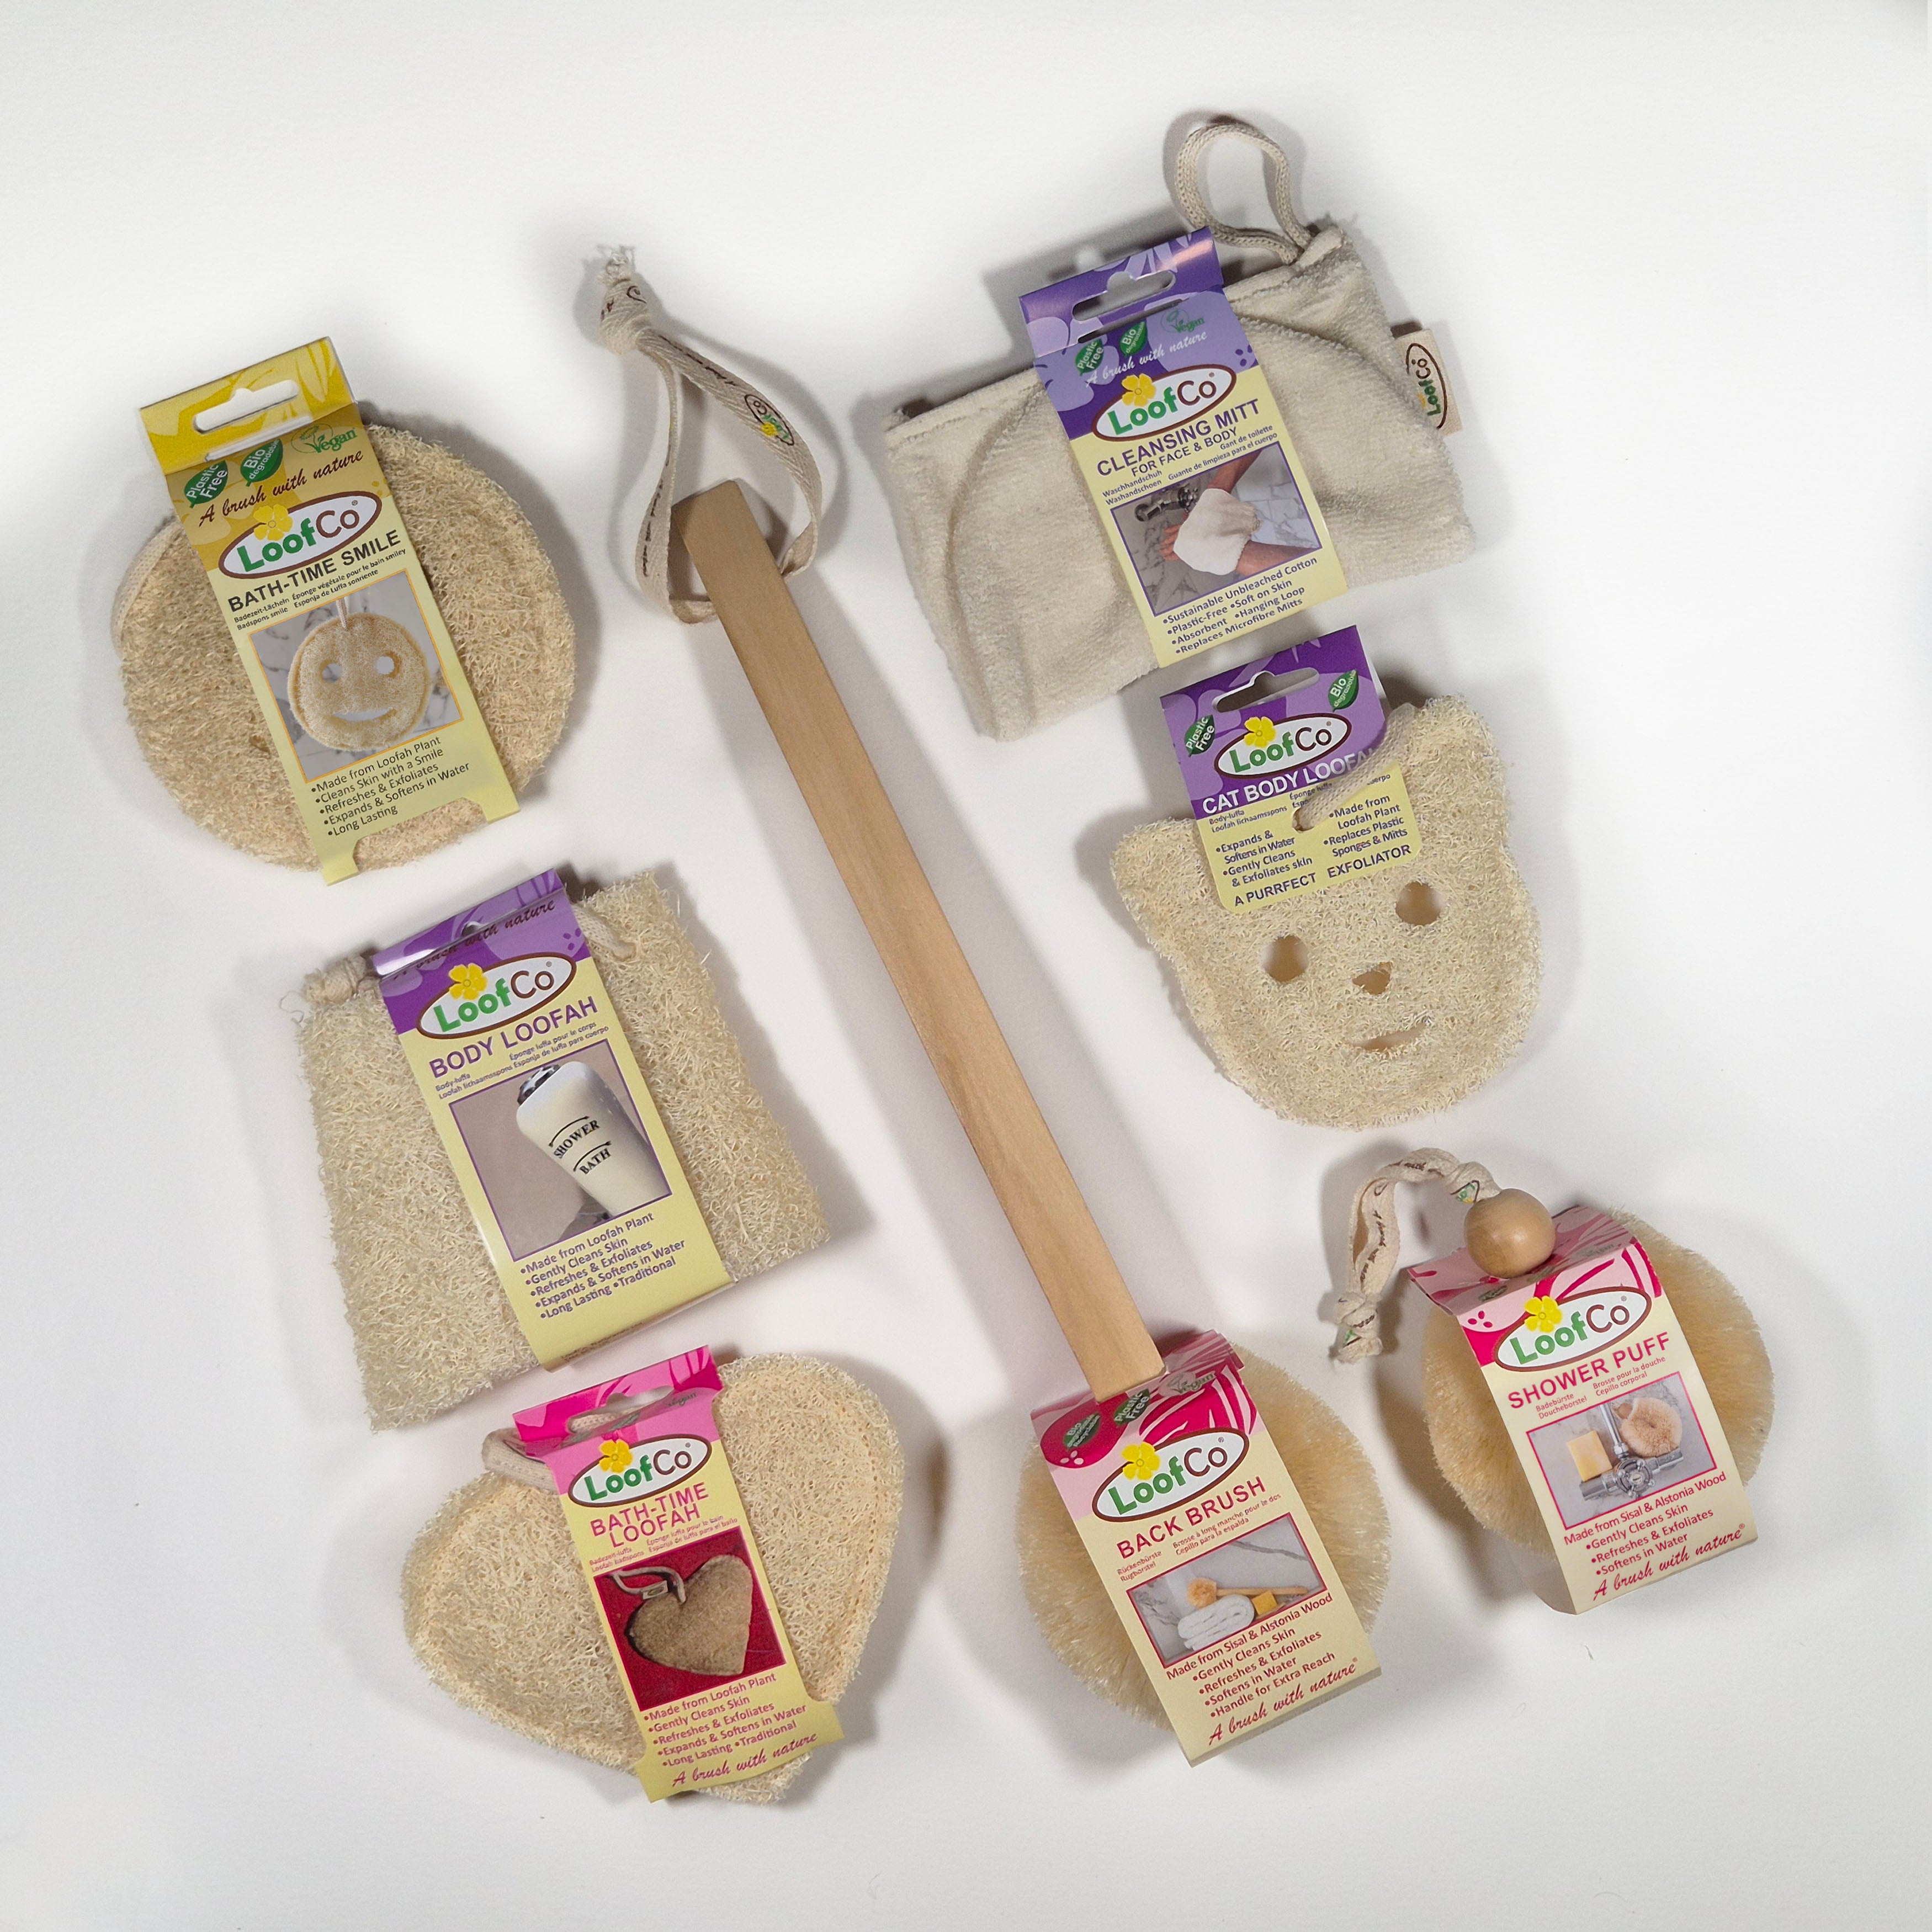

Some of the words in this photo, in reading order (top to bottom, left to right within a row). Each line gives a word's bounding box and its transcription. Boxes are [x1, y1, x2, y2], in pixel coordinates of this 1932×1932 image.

[1122, 328, 1136, 345] Bio
[1077, 341, 1097, 369] Plastic
[1085, 371, 1098, 388] A
[1102, 355, 1135, 379] brush
[1139, 343, 1165, 364] with
[1169, 331, 1208, 353] nature
[1086, 346, 1103, 369] Free
[1097, 420, 1212, 476] CLEANSING
[1214, 398, 1259, 429] MITT
[1131, 460, 1158, 477] FOR
[1159, 445, 1191, 466] FACE
[1193, 442, 1203, 452] &
[1203, 426, 1236, 448] BODY
[1220, 439, 1237, 450] Gant
[1248, 425, 1273, 439] toilette
[243, 448, 266, 468] Bio
[1168, 467, 1192, 480] Guante
[1202, 452, 1231, 466] limpieza
[1231, 445, 1246, 457] para
[1247, 440, 1254, 449] el
[1254, 433, 1278, 445] cuerpo
[186, 465, 219, 498] Plastic
[199, 470, 227, 498] Free
[199, 504, 215, 527] A
[222, 485, 267, 517] brush
[272, 468, 307, 496] with
[313, 450, 363, 479] nature
[1102, 470, 1163, 497] Waschhandschuh
[1105, 480, 1162, 506] Washandschoen
[227, 558, 337, 612] BATH-TIME
[341, 529, 401, 566] SMILE
[233, 598, 290, 623] Badezeit-Lächeln
[291, 587, 317, 601] Éponge
[317, 575, 346, 590] végétale
[346, 567, 361, 579] pour
[369, 558, 385, 568] bain
[385, 549, 406, 561] smiley
[1225, 569, 1283, 599] Unbleached
[1285, 558, 1317, 575] Cotton
[237, 615, 270, 630] Badspons
[270, 607, 288, 618] smile
[294, 595, 320, 608] Esponja
[330, 583, 347, 593] Luffa
[348, 570, 378, 586] sonriente
[1257, 590, 1270, 599] on
[1271, 580, 1292, 593] Skin
[1280, 587, 1305, 601] Loop
[1224, 610, 1275, 634] Microfibre
[1276, 599, 1303, 613] Mitts
[1186, 716, 1209, 750] Plastic
[1196, 724, 1215, 752] Free
[349, 765, 375, 779] from
[376, 748, 412, 768] Loofah
[413, 736, 441, 753] Plant
[357, 776, 379, 789] Skin
[380, 764, 405, 779] with
[415, 749, 443, 766] Smile
[1202, 789, 1240, 814] CAT
[1244, 769, 1298, 803] BODY
[1303, 748, 1374, 784] LOOFA
[360, 805, 398, 825] Lasting
[1372, 816, 1404, 832] Plastic
[1262, 850, 1296, 865] Cleans
[1332, 840, 1372, 857] Sponges
[1372, 835, 1382, 845] &
[1382, 829, 1408, 842] Mitts
[1232, 878, 1241, 887] &
[1242, 864, 1291, 884] Exfoliates
[1292, 857, 1313, 869] skin
[1235, 895, 1244, 906] A
[1246, 872, 1315, 903] PURRFECT
[1326, 845, 1411, 878] EXFOLIATOR
[429, 1036, 493, 1079] BODY
[500, 996, 598, 1049] LOOFAH
[553, 1120, 600, 1159] SHOWER
[580, 1148, 611, 1174] BATH
[587, 1277, 598, 1287] &
[598, 1260, 639, 1283] Softens
[640, 1255, 651, 1265] in
[651, 1240, 684, 1259] Water
[572, 1285, 612, 1307] Lasting
[1508, 1358, 1610, 1409] SHOWER
[1612, 1331, 1669, 1369] PUFF
[1593, 1377, 1615, 1389] Brosse
[1616, 1370, 1632, 1381] pour
[1641, 1356, 1665, 1371] douche
[1595, 1384, 1619, 1397] Cepillo
[1620, 1370, 1648, 1387] corporal
[1535, 1393, 1574, 1413] Badebürste
[1538, 1395, 1588, 1419] Doucheborstel
[590, 1482, 709, 1537] BATH-TIME
[609, 1503, 700, 1548] LOOFAH
[1116, 1515, 1183, 1559] BACK
[1185, 1476, 1266, 1526] BRUSH
[1563, 1528, 1594, 1546] Made
[1594, 1517, 1620, 1533] from
[1620, 1505, 1643, 1522] Sisal
[1643, 1502, 1654, 1513] &
[1655, 1487, 1695, 1509] Alstonia
[1694, 1471, 1727, 1492] Wood
[1593, 1579, 1607, 1601] A
[1613, 1561, 1654, 1591] brush
[1659, 1545, 1690, 1572] with
[1255, 1684, 1270, 1696] for
[1272, 1670, 1301, 1688] Extra
[1302, 1652, 1335, 1674] Reach
[712, 1718, 721, 1728] &
[723, 1703, 774, 1726] Exfoliates
[1209, 1723, 1223, 1746] A
[1229, 1701, 1268, 1734] brush
[1273, 1683, 1304, 1712] with
[672, 1771, 686, 1787] A
[692, 1760, 731, 1782] brush
[736, 1748, 767, 1771] with
[772, 1733, 818, 1758] nature
